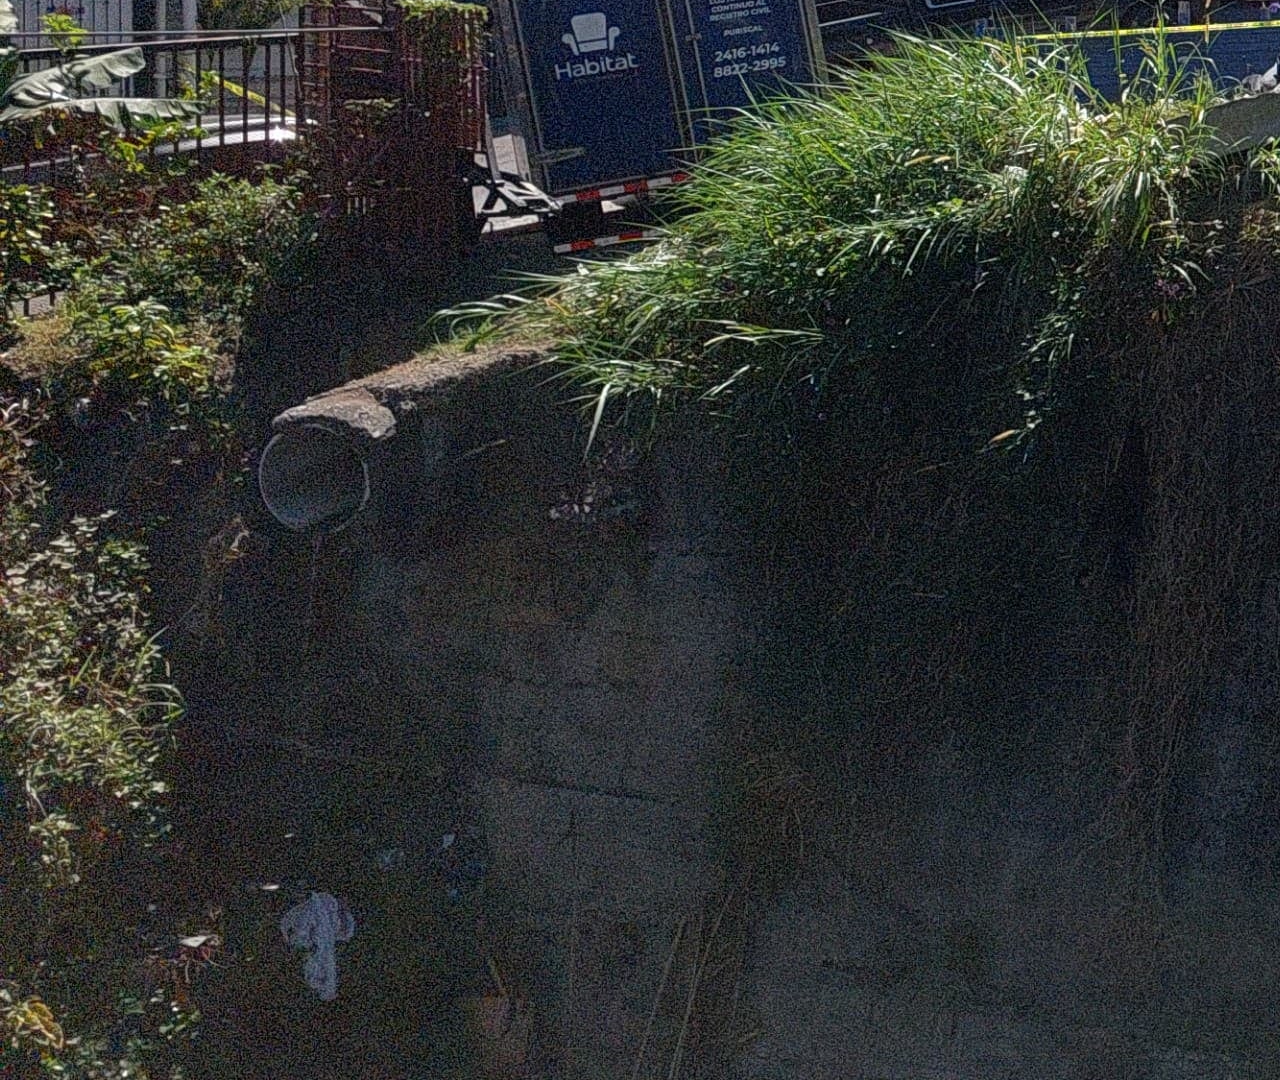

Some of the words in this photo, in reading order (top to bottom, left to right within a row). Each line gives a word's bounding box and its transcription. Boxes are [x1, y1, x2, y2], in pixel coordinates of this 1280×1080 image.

[751, 6, 771, 15] CIVIL
[755, 0, 767, 7] AL
[723, 25, 763, 37] PURISCAL
[714, 42, 780, 62] 2416-1414
[554, 53, 639, 80] Habitat
[713, 56, 786, 78] 8822-2995
